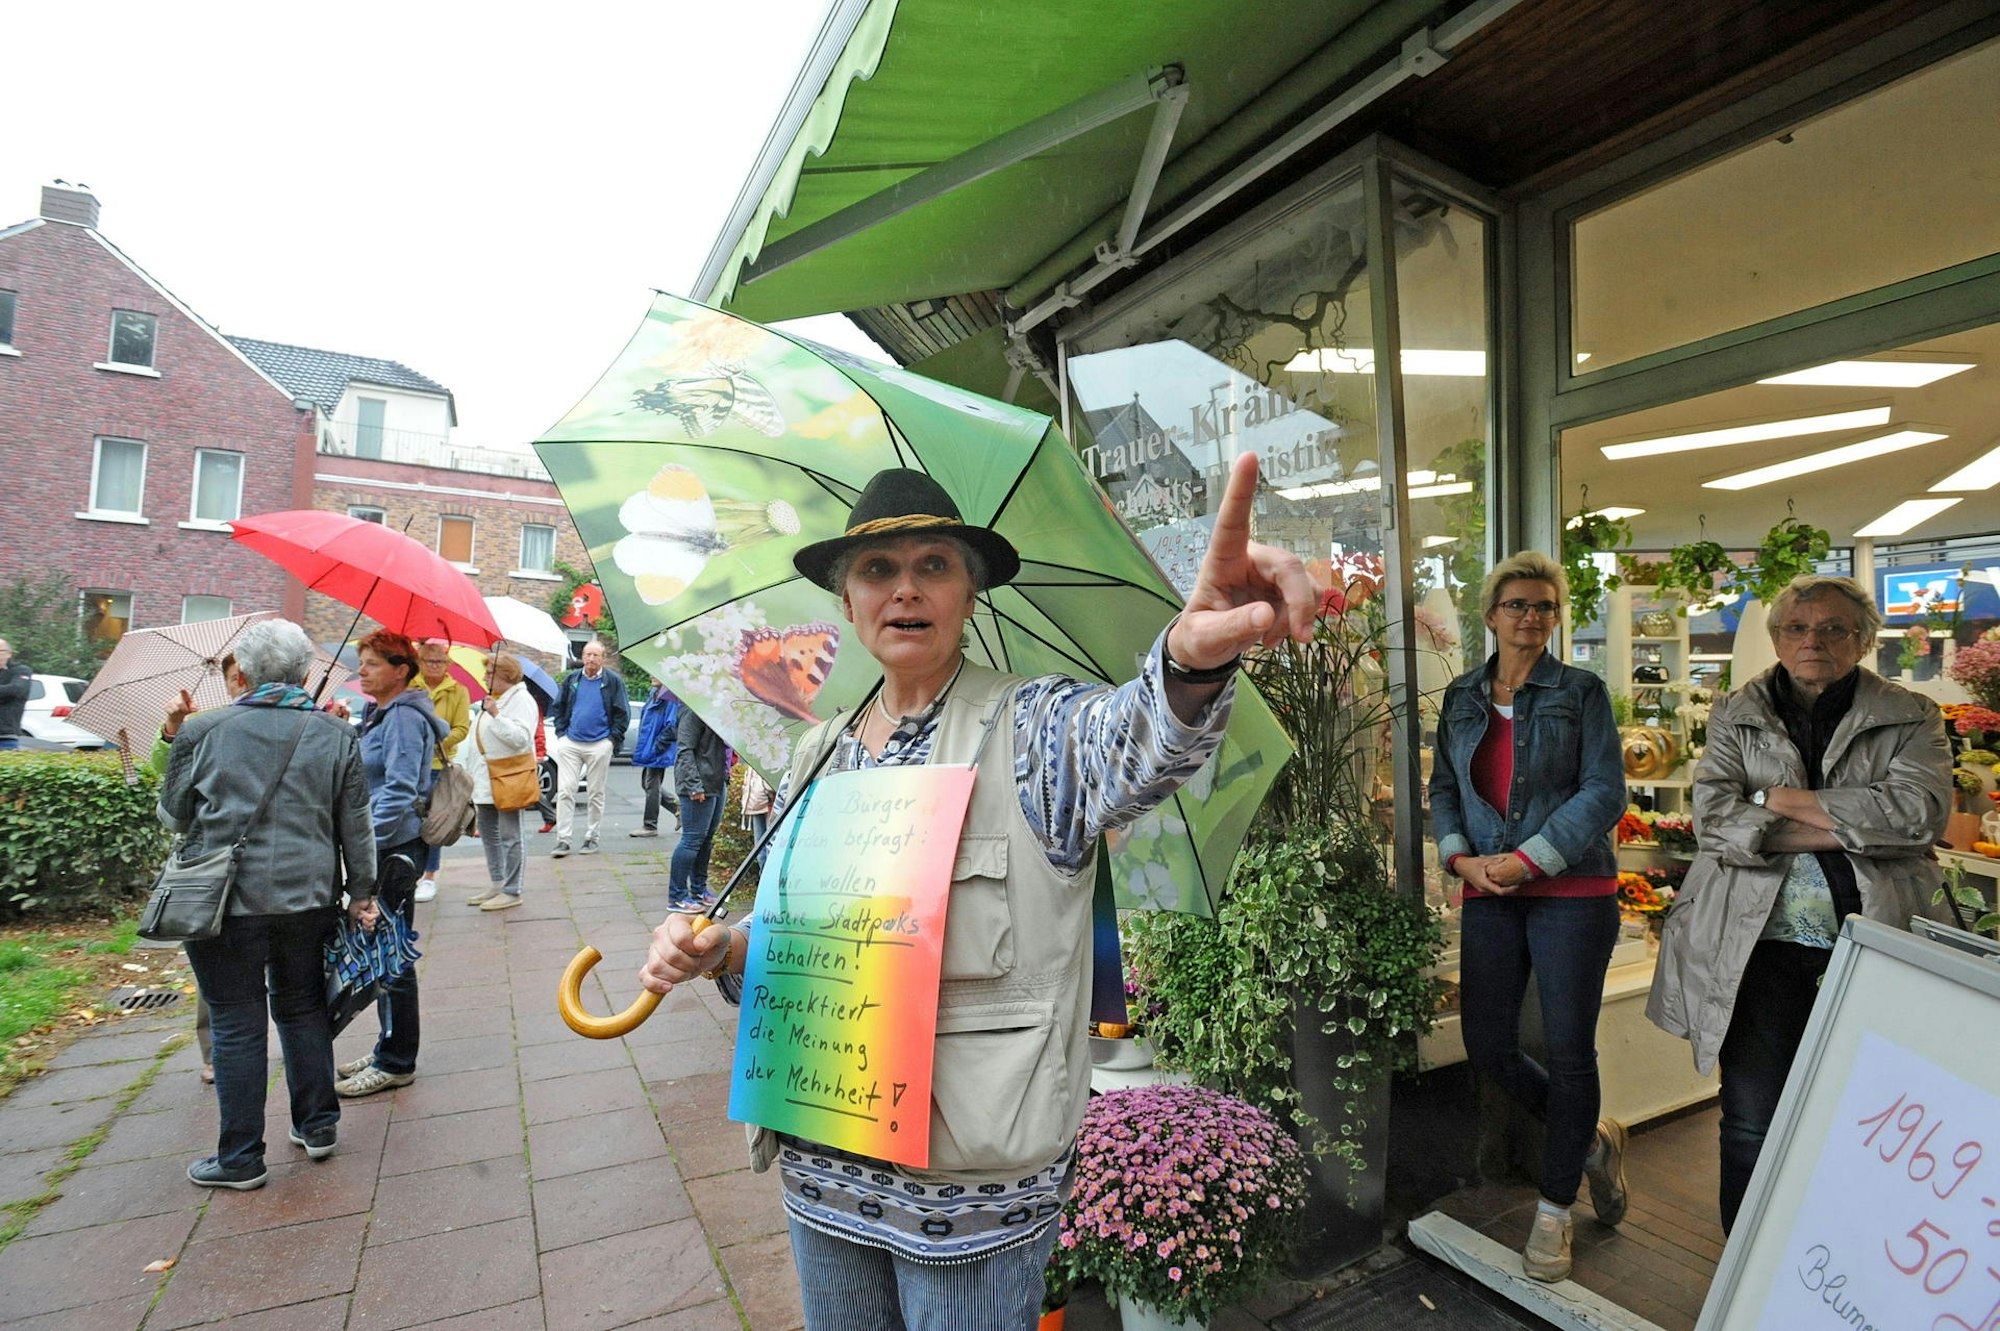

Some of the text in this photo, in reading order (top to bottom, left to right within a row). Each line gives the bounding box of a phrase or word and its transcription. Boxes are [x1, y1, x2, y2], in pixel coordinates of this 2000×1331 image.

[819, 863, 877, 893] wollen
[765, 935, 861, 971] behalten!
[753, 984, 882, 1024] Respektiert
[749, 1015, 868, 1072] die Meinung
[745, 1055, 776, 1081] der
